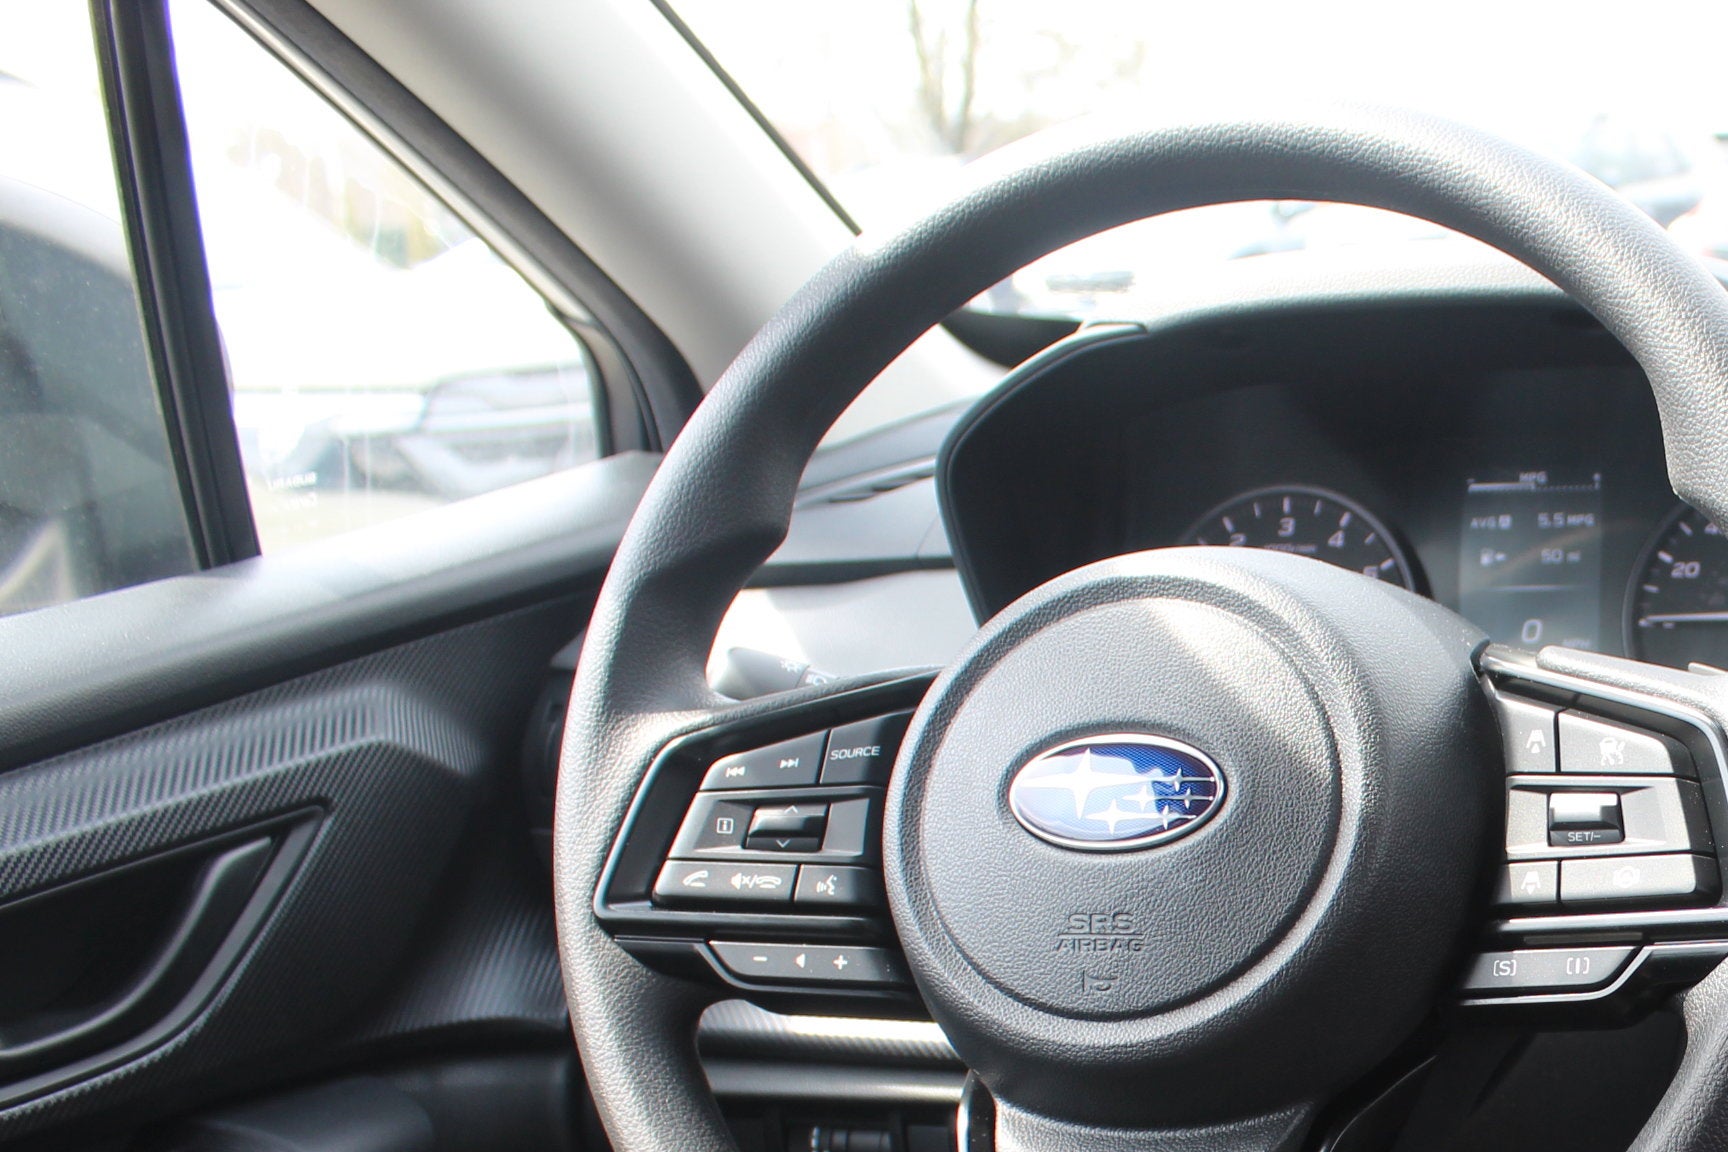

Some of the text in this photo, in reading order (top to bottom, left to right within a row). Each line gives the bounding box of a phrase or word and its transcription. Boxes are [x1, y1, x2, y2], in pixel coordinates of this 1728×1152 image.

[1278, 517, 1296, 538] 3
[1538, 512, 1565, 528] 5.5
[1328, 530, 1345, 548] 4
[1671, 561, 1700, 579] 20
[1521, 619, 1544, 644] 0
[830, 746, 881, 760] SOURCE
[1068, 912, 1135, 935] SRS
[1055, 938, 1146, 952] AIRBAG
